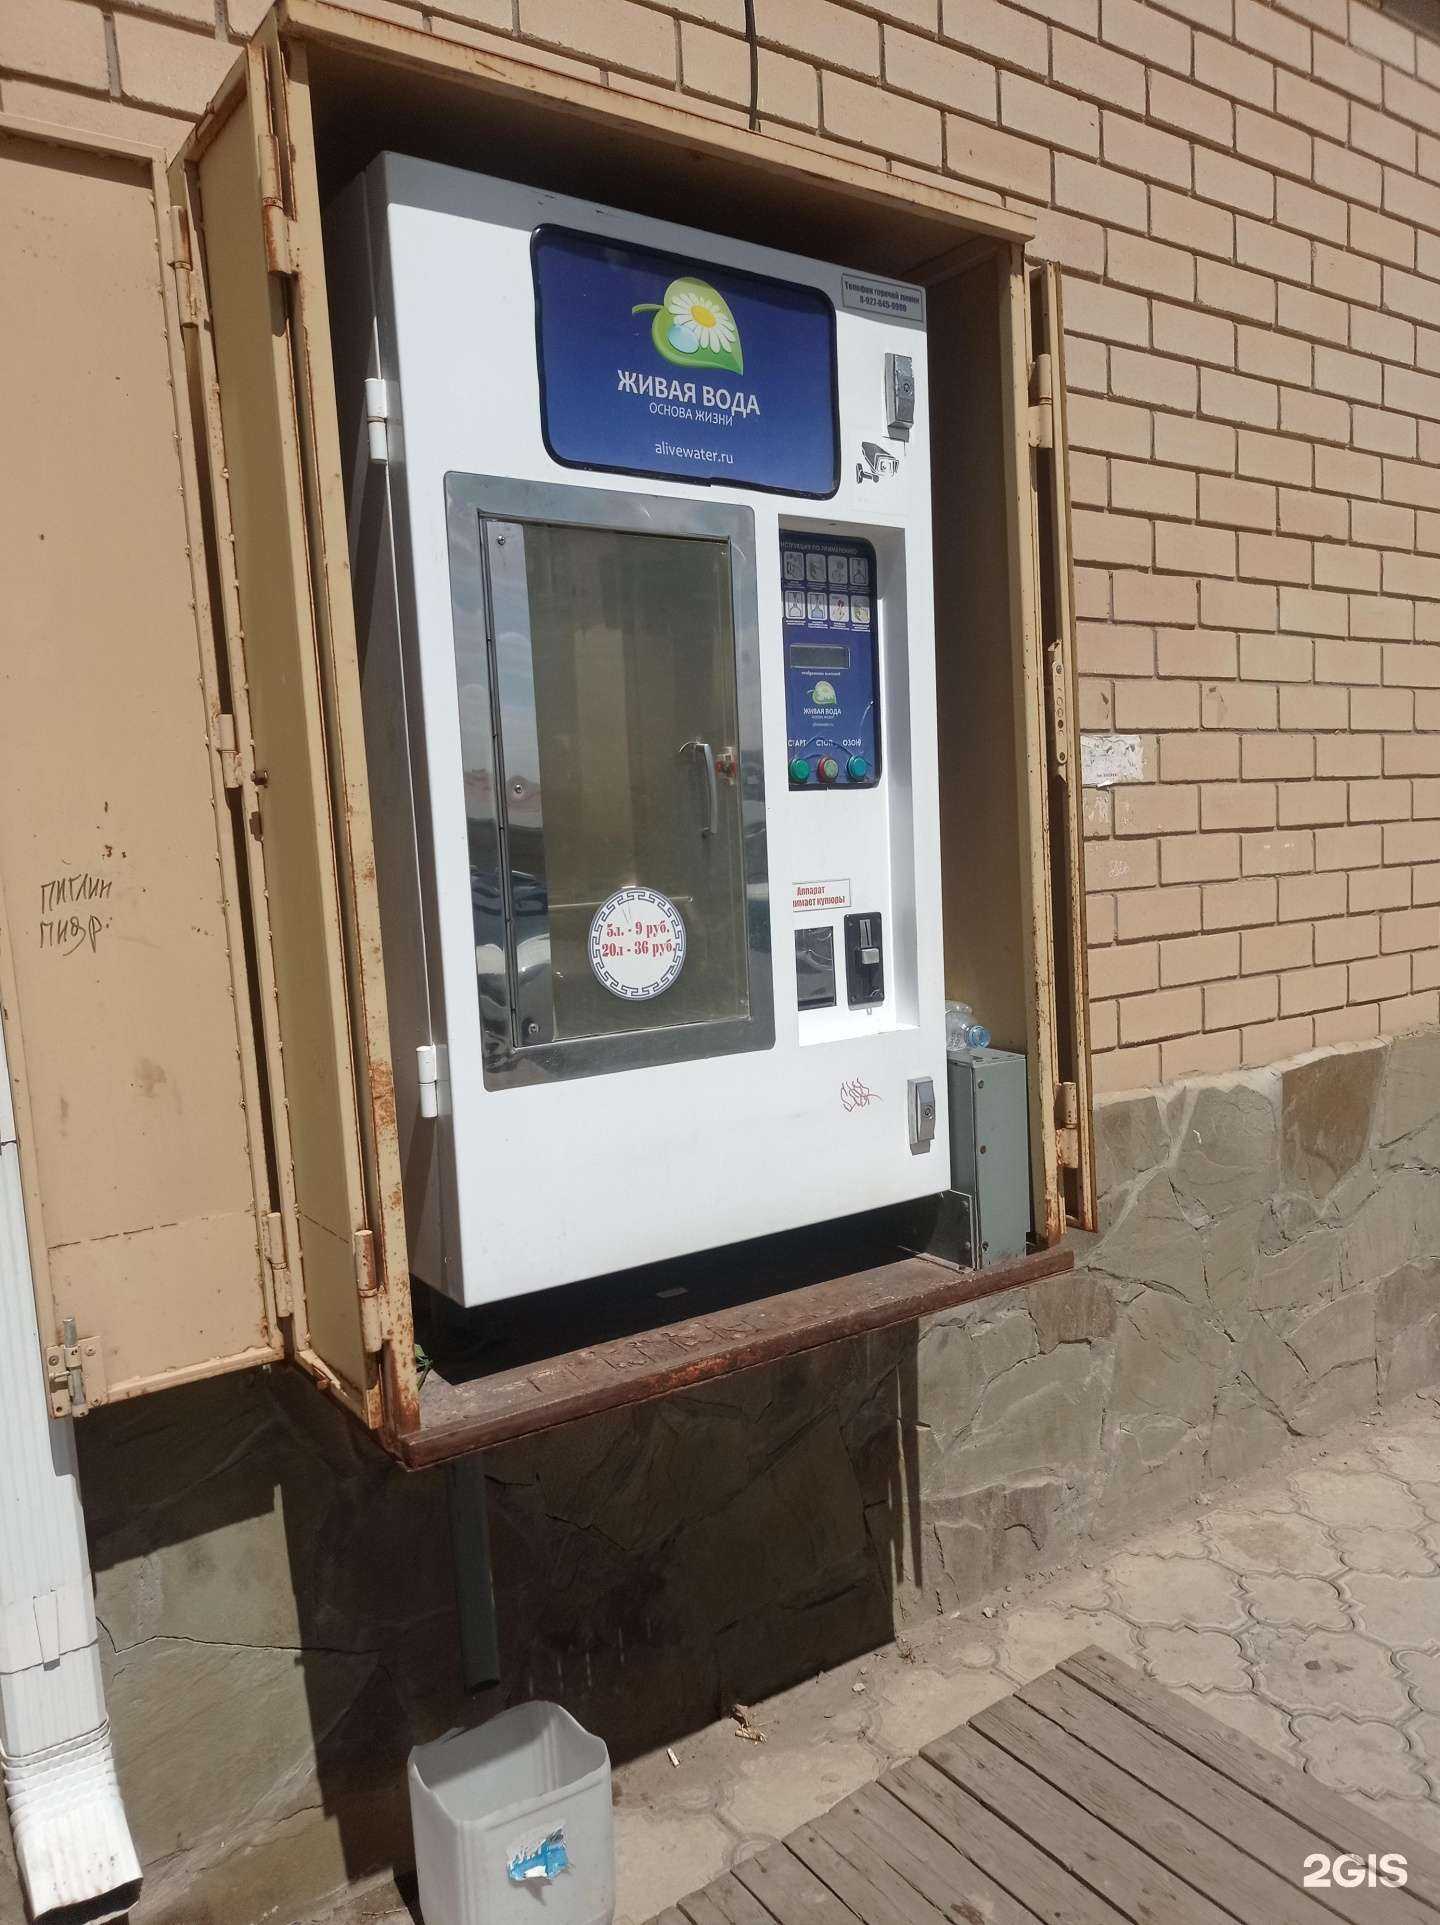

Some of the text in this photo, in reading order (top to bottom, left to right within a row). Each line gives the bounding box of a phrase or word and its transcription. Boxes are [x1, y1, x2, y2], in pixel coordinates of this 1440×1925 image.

[617, 369, 761, 418] ЖИВАЯ ВОДА
[650, 402, 733, 427] ОСНОВА ЖИЗНИ
[655, 440, 734, 464] alivewater.ru
[825, 708, 842, 718] ВОДА
[797, 886, 825, 897] Аппарат
[816, 895, 846, 906] купюры
[635, 921, 643, 935] 9
[646, 920, 670, 938] руб.
[634, 940, 650, 956] 36
